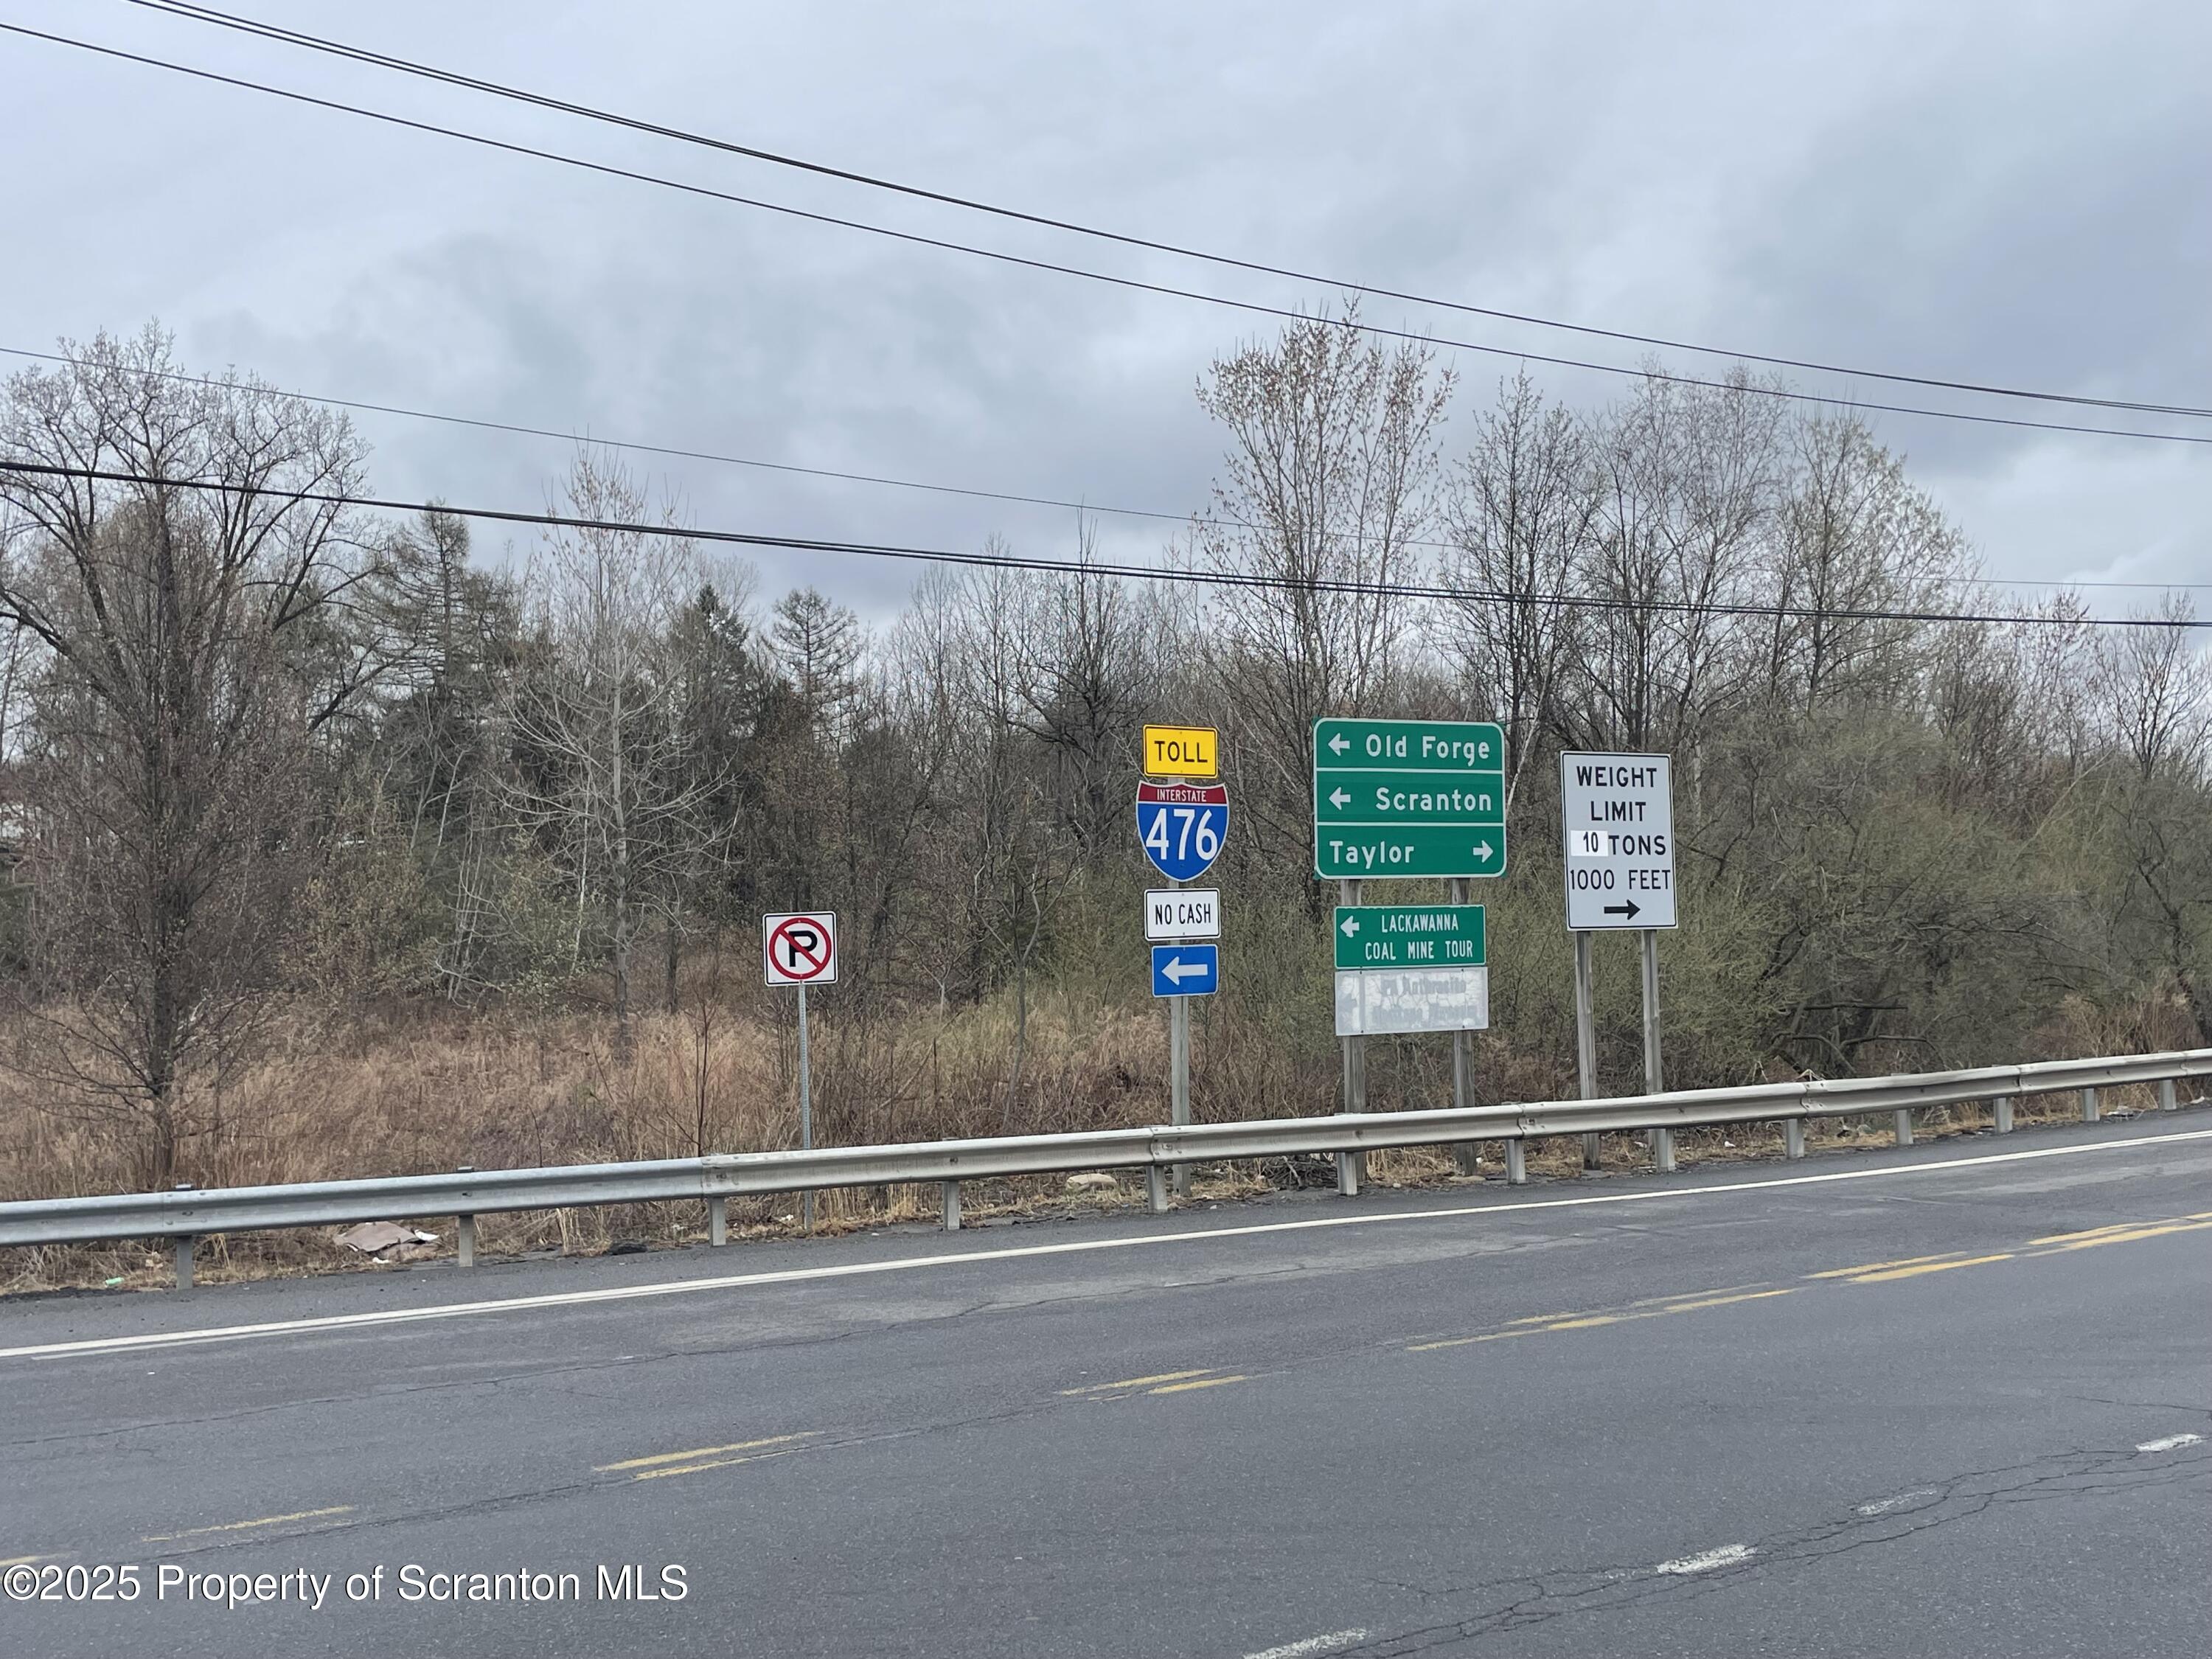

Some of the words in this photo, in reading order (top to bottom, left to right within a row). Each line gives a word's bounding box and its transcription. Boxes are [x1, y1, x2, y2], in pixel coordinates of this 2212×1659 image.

[1154, 740, 1208, 763] TOLL
[1366, 734, 1407, 758] Old
[1422, 735, 1491, 767] Forge
[1576, 765, 1658, 788] WEIGHT
[1156, 788, 1207, 803] INTERSTATE
[1375, 787, 1492, 812] Scranton
[1590, 801, 1646, 822] LIMIT
[1145, 807, 1218, 861] 476
[1583, 831, 1599, 853] 10
[1608, 834, 1667, 856] TONS
[1329, 840, 1415, 870] Taylor
[1570, 869, 1615, 891] 1000
[1628, 869, 1671, 890] FEET
[1155, 904, 1172, 925] NO
[1178, 902, 1211, 925] CASH
[1381, 914, 1459, 933] LACKAWANNA
[1365, 942, 1397, 961] COAL
[1408, 940, 1435, 960] MINE
[1444, 939, 1473, 959] TOUR
